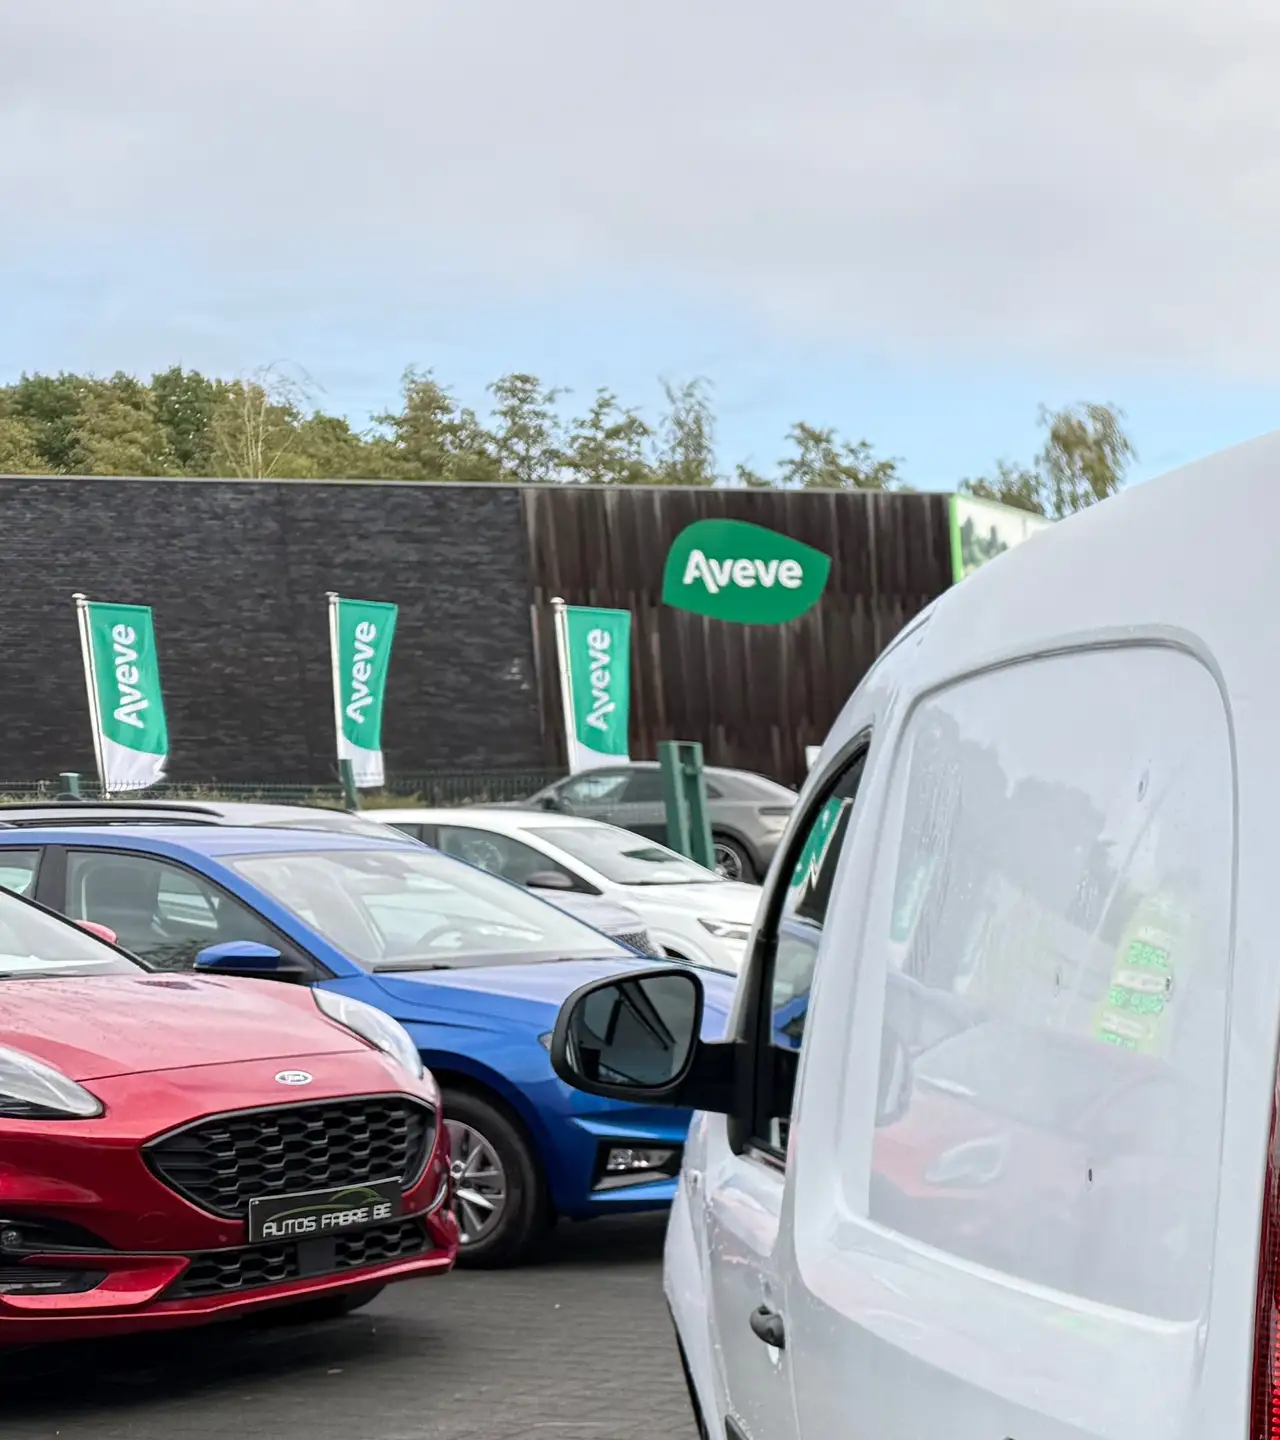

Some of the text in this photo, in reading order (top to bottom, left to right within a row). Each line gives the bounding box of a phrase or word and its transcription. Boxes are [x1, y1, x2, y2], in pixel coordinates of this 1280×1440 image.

[682, 549, 804, 594] Aveve
[112, 623, 149, 729] Aveve
[346, 621, 377, 725] Aveve
[586, 628, 616, 732] Aveve
[263, 1216, 316, 1238] AUTOS
